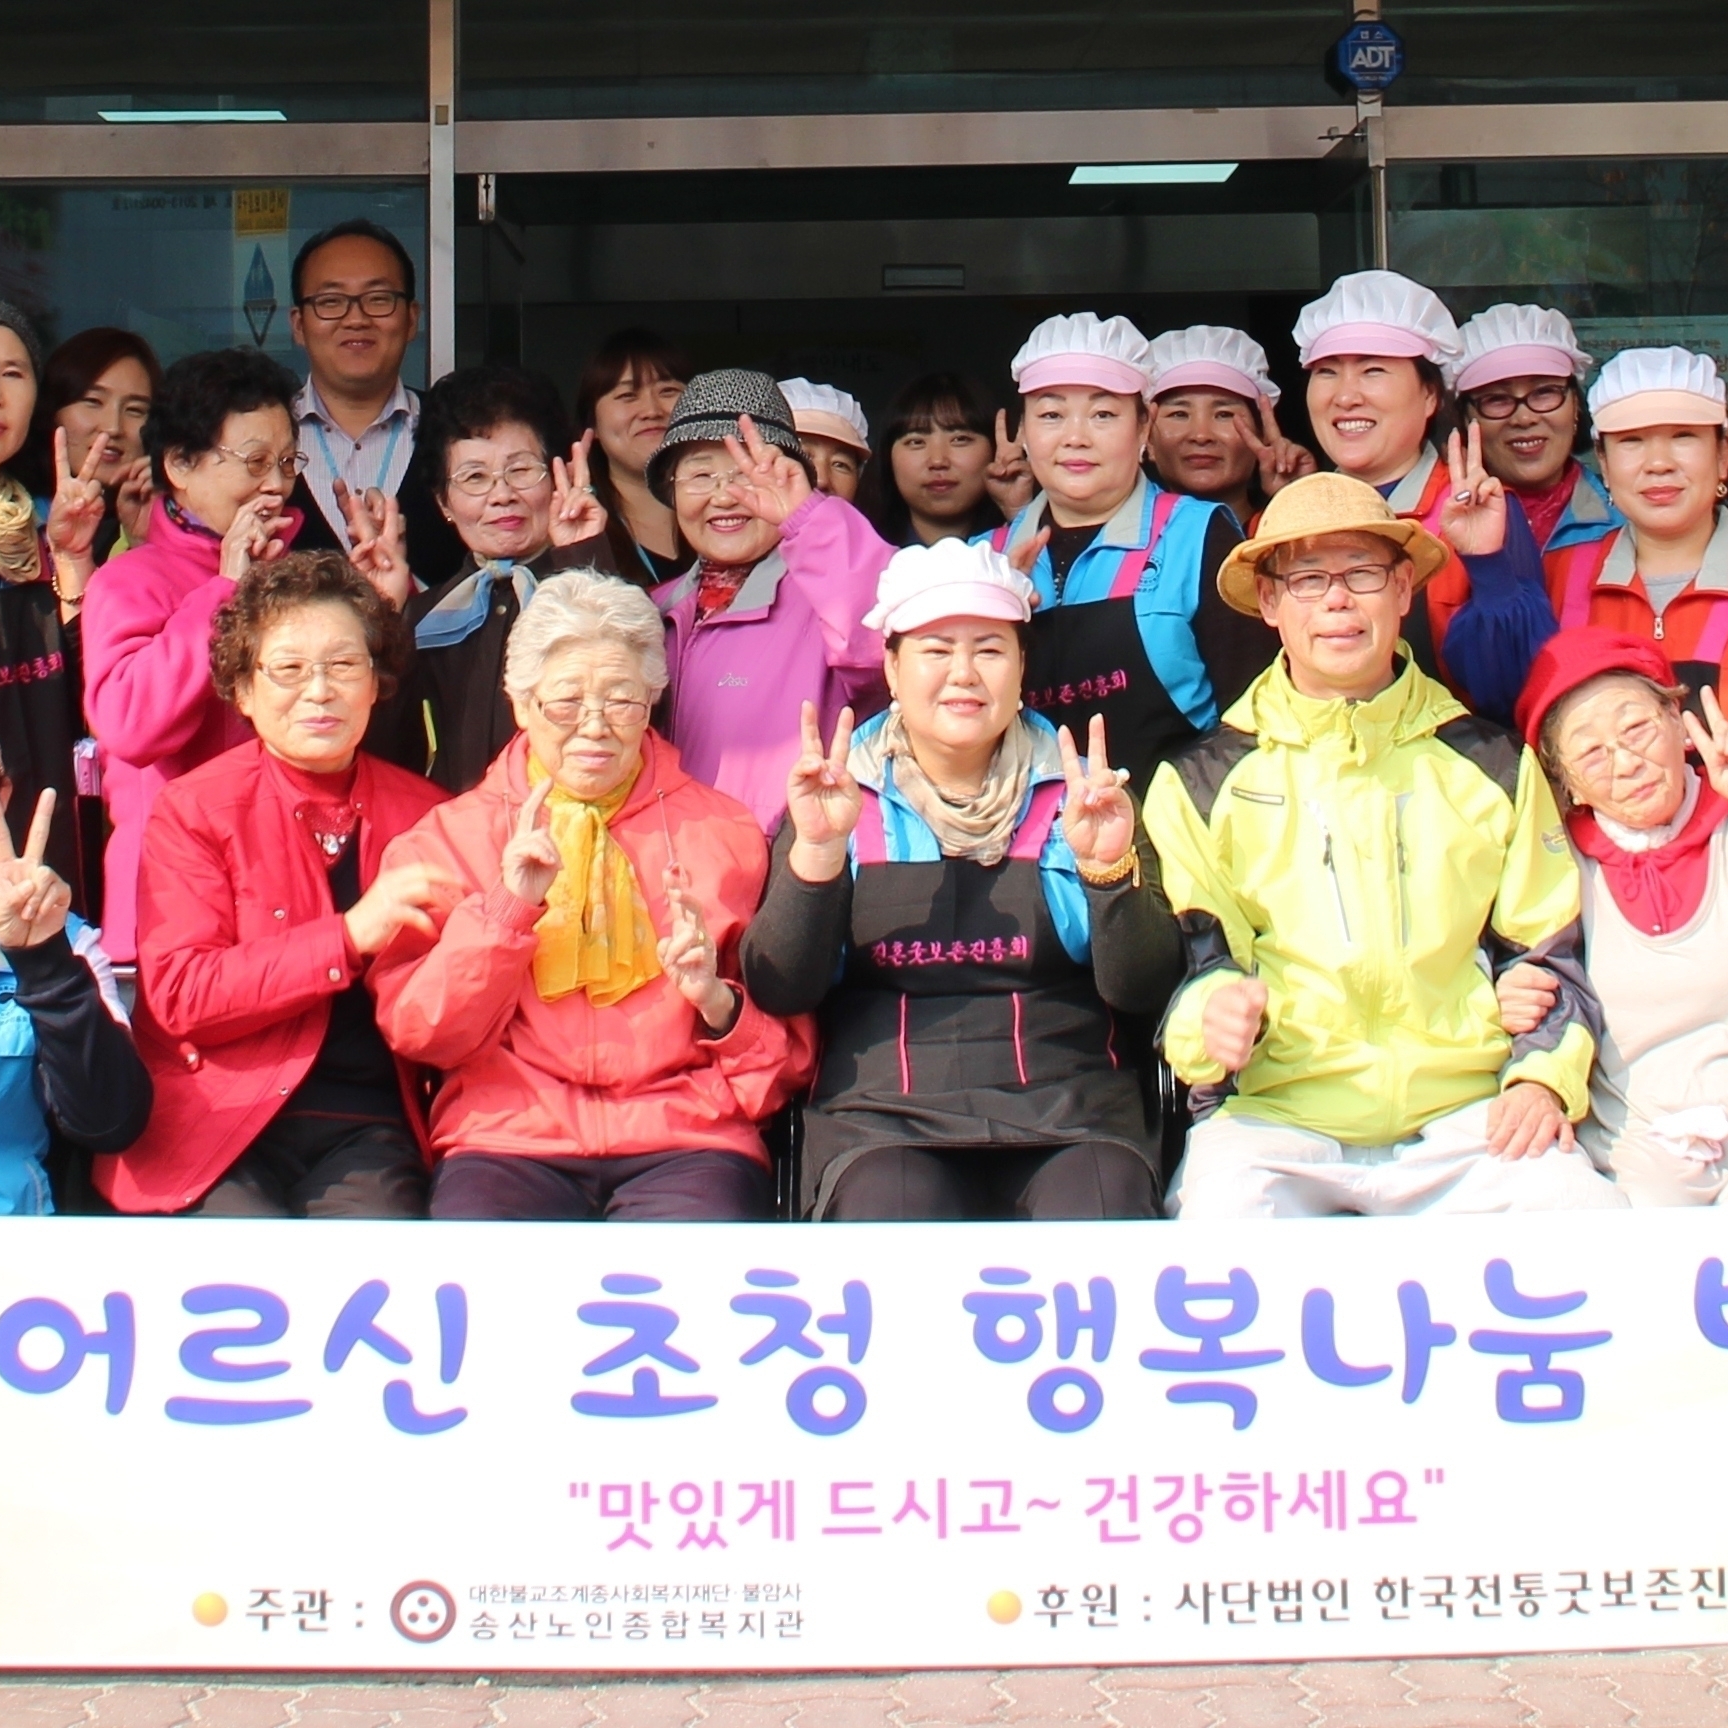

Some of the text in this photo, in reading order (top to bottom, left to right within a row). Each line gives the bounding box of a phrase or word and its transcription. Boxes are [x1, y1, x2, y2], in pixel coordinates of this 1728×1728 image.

[1350, 45, 1396, 68] ADT
[570, 1270, 872, 1437] 초청
[962, 1260, 1613, 1435] 행복나눔
[568, 1467, 1446, 1552] "맛있게 드시고~ 건강하세요"
[244, 1587, 333, 1634] 주관
[469, 1609, 806, 1641] 송산노인종합복지관
[1033, 1581, 1120, 1628] 후원
[1173, 1576, 1351, 1624] 사단법인
